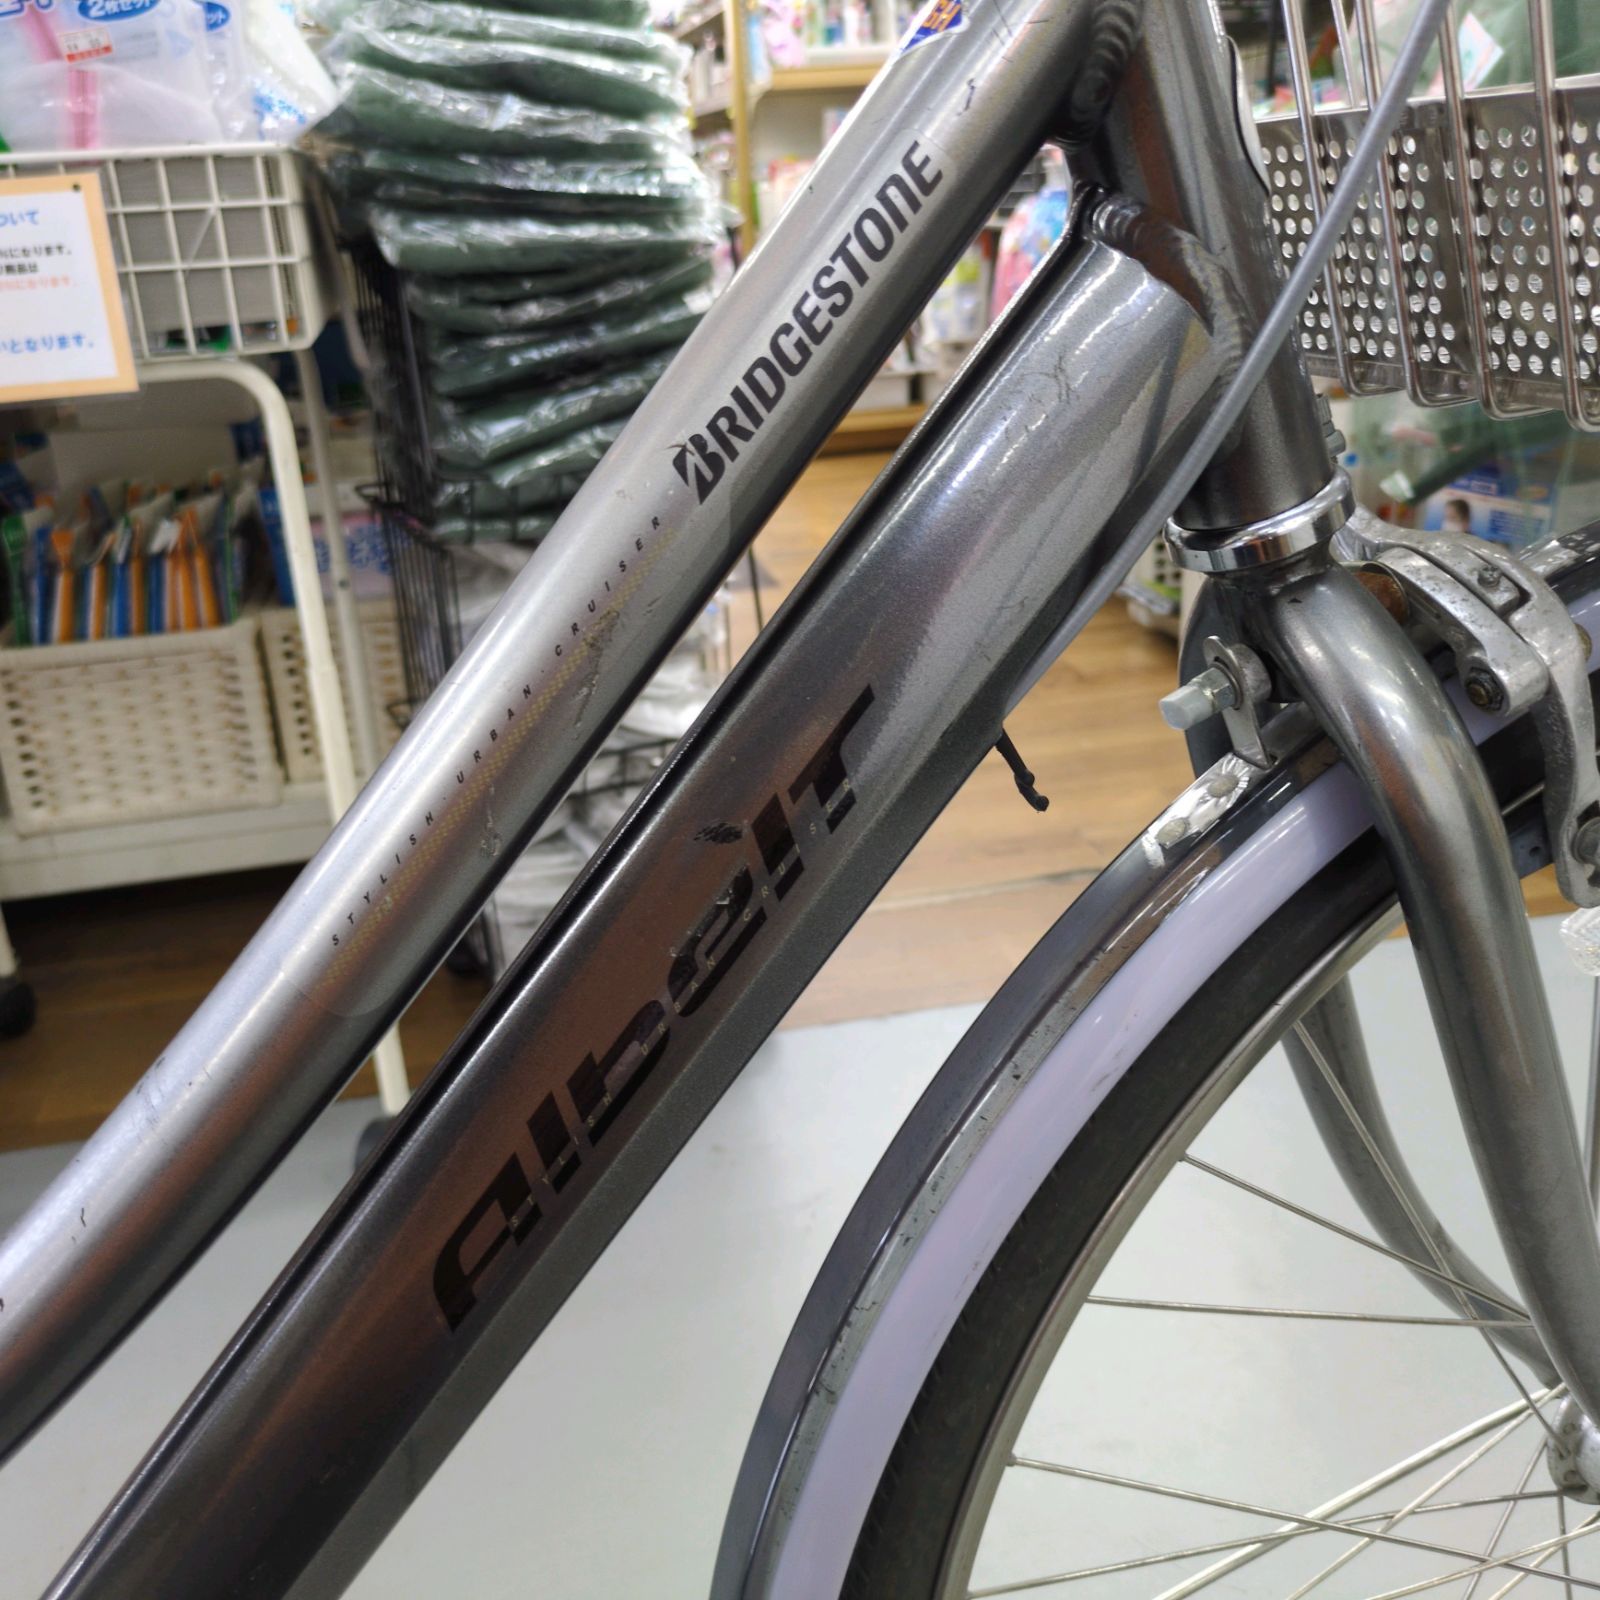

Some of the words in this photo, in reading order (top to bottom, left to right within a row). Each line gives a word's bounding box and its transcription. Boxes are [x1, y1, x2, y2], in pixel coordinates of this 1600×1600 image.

[672, 140, 943, 505] BRIDGESTONE
[332, 812, 434, 945] STYLISH
[457, 685, 532, 785] URBAN
[554, 516, 660, 656] CRUISER
